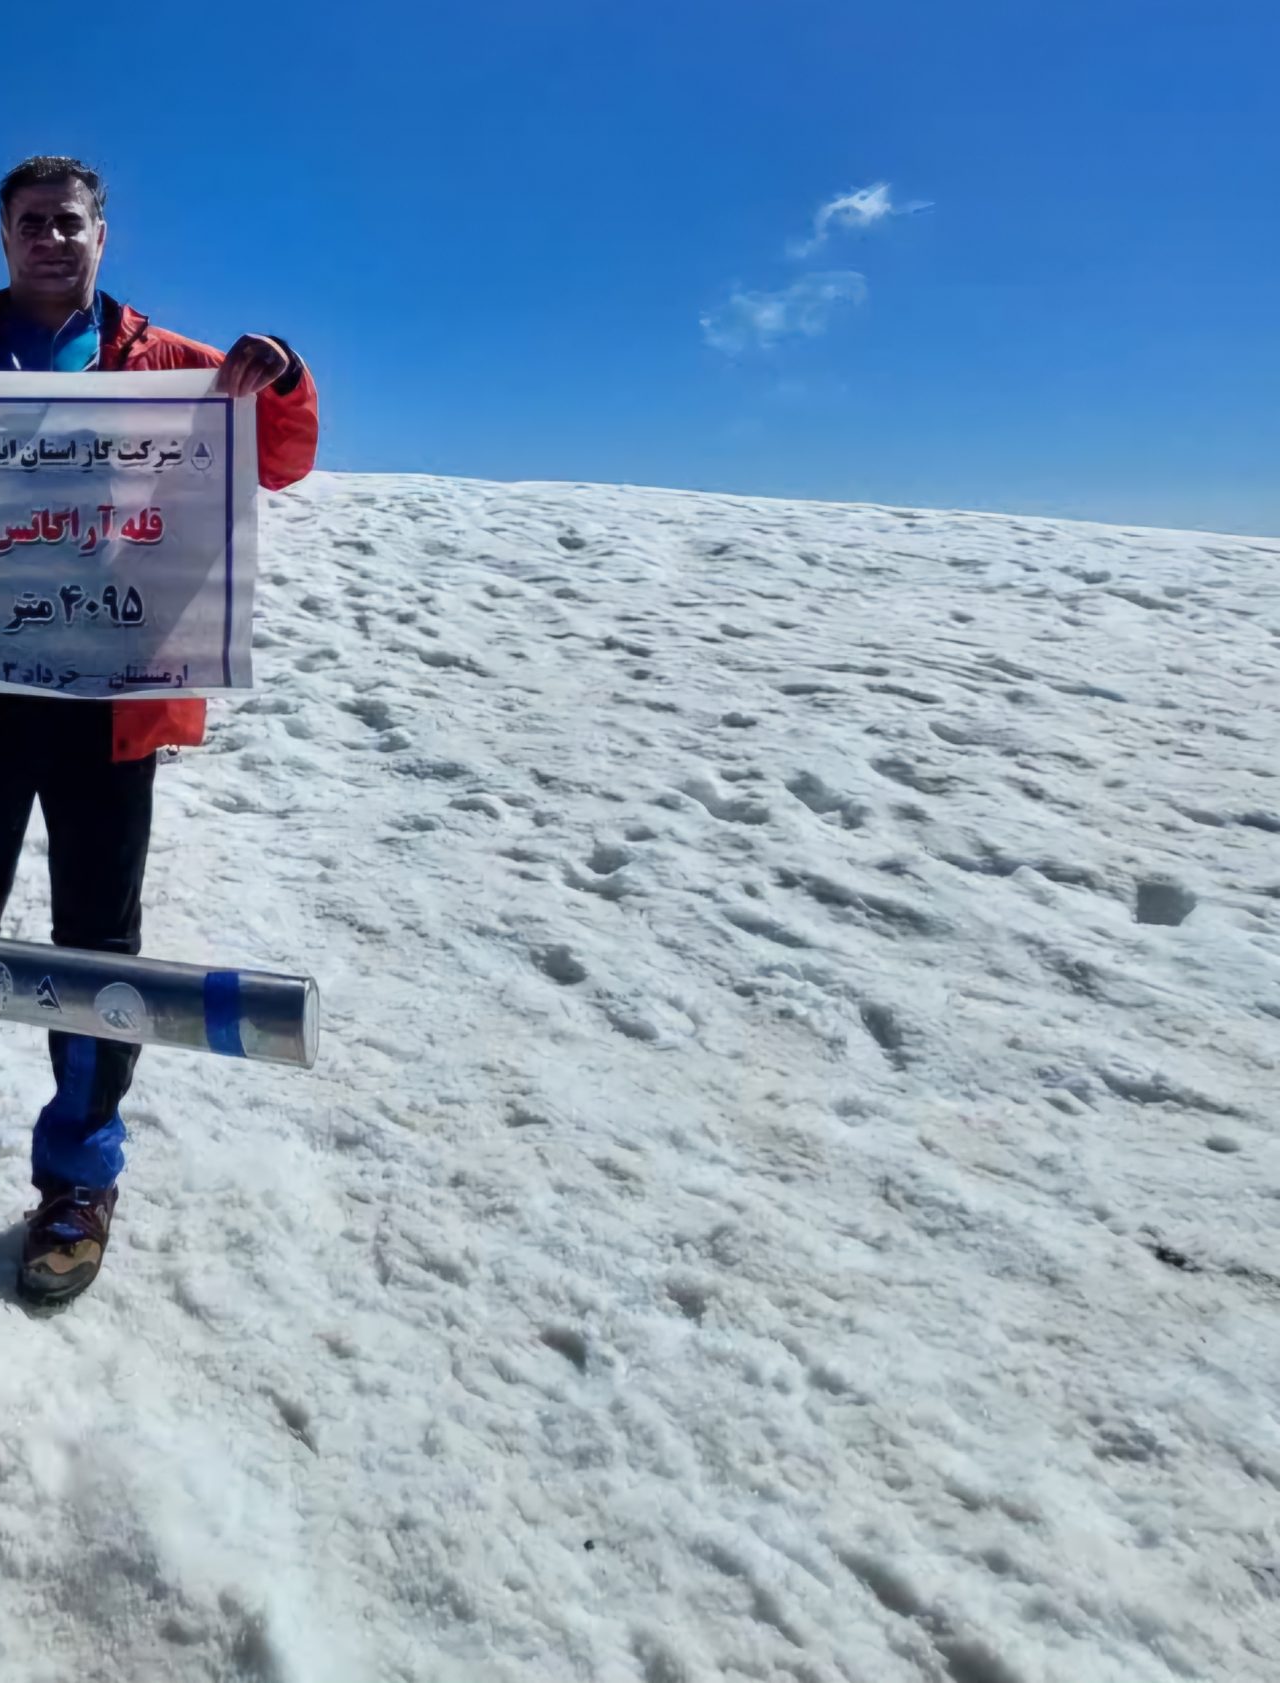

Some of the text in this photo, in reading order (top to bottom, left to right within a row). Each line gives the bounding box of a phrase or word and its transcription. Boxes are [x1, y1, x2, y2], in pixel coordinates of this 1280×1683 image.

[20, 437, 76, 468] استان
[79, 438, 113, 469] گاز
[116, 439, 183, 473] شرکت
[120, 506, 164, 543] قله
[2, 584, 144, 634] ۴۰۹۵ متر
